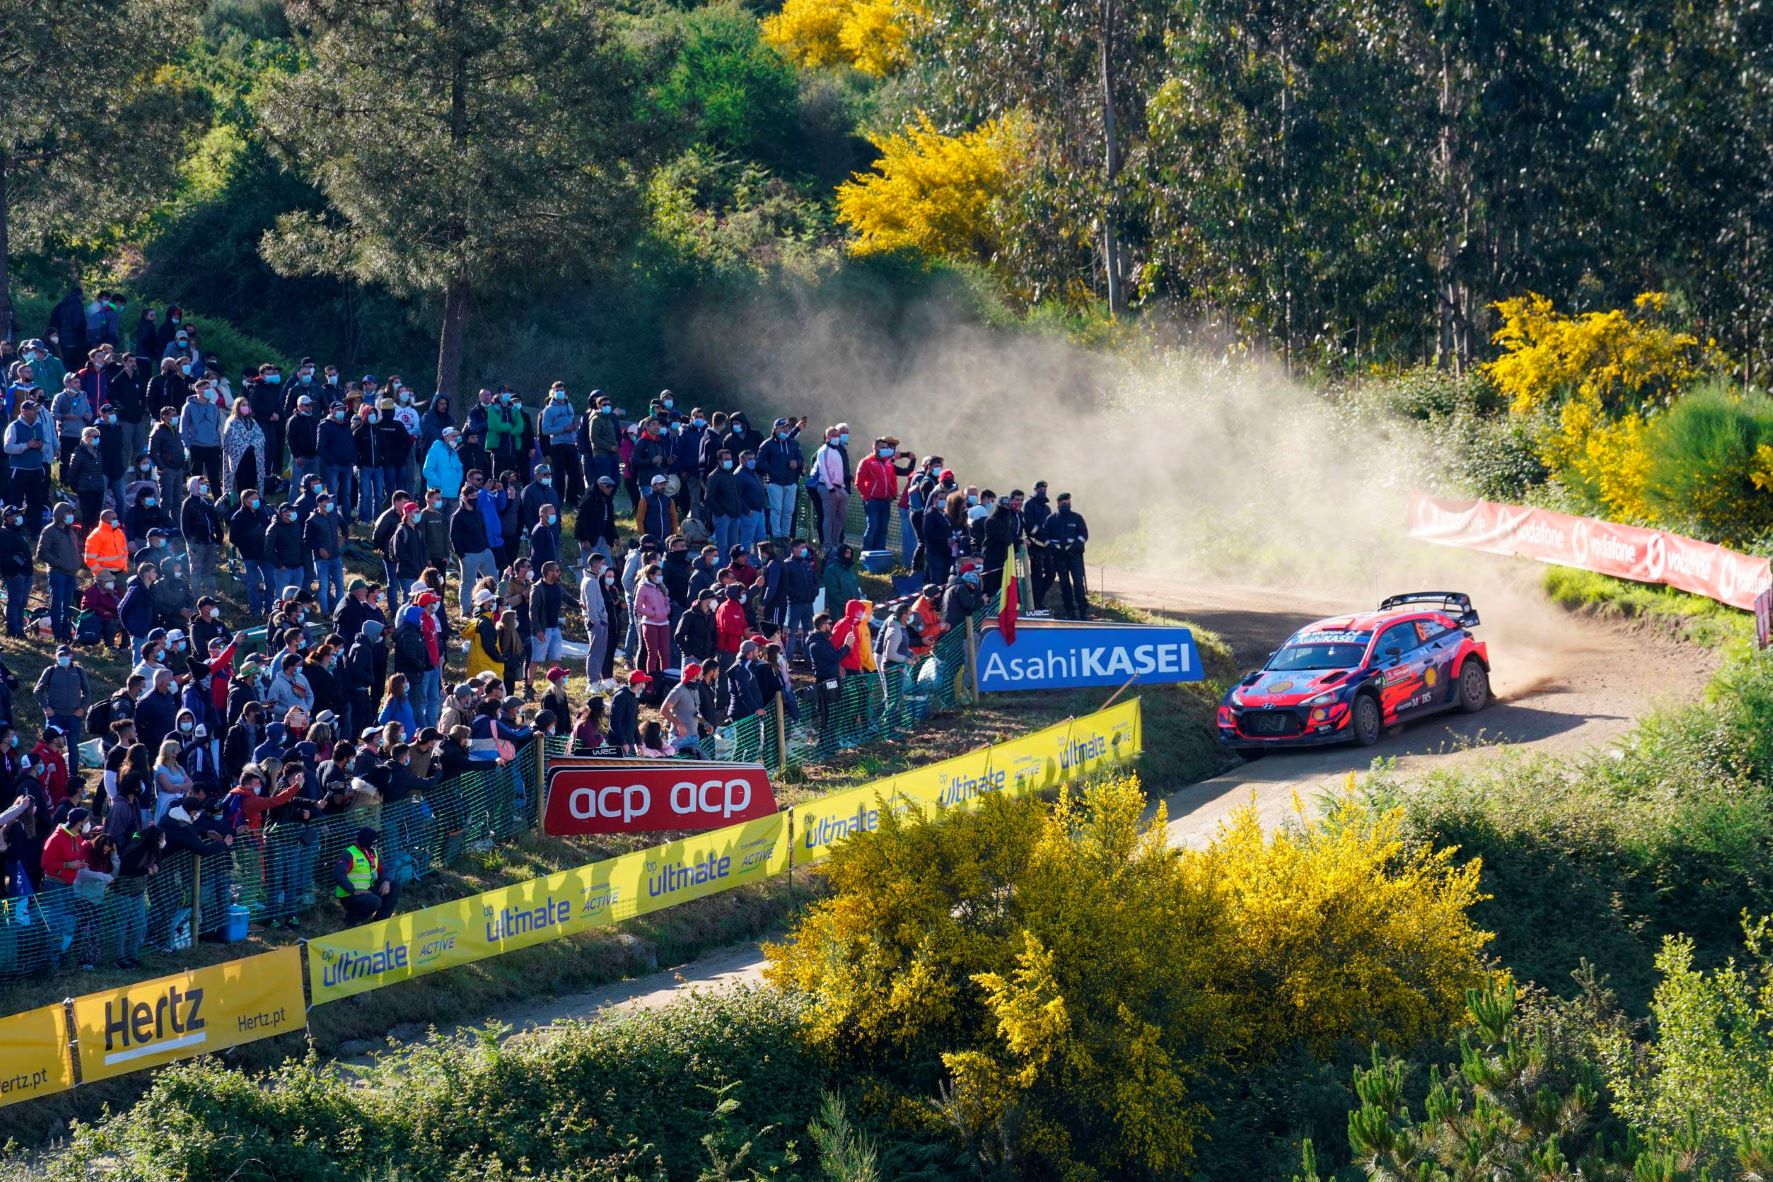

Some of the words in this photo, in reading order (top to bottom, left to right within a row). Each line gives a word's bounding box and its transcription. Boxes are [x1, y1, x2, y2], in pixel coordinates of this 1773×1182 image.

[1589, 534, 1636, 564] vodafone
[1060, 732, 1106, 769] ultimate
[569, 784, 650, 823] acp
[670, 779, 751, 818] acp
[939, 766, 1005, 805] ultimate
[805, 804, 878, 848] ultimate
[649, 852, 731, 897] ultimate
[741, 848, 774, 867] ACTIVE
[486, 896, 571, 942] ultimate
[582, 891, 620, 912] ACTIVE
[323, 941, 408, 987] ultimate
[419, 936, 456, 957] ACTIVE
[105, 986, 205, 1051] Hertz
[237, 1007, 286, 1032] Hertz.pt
